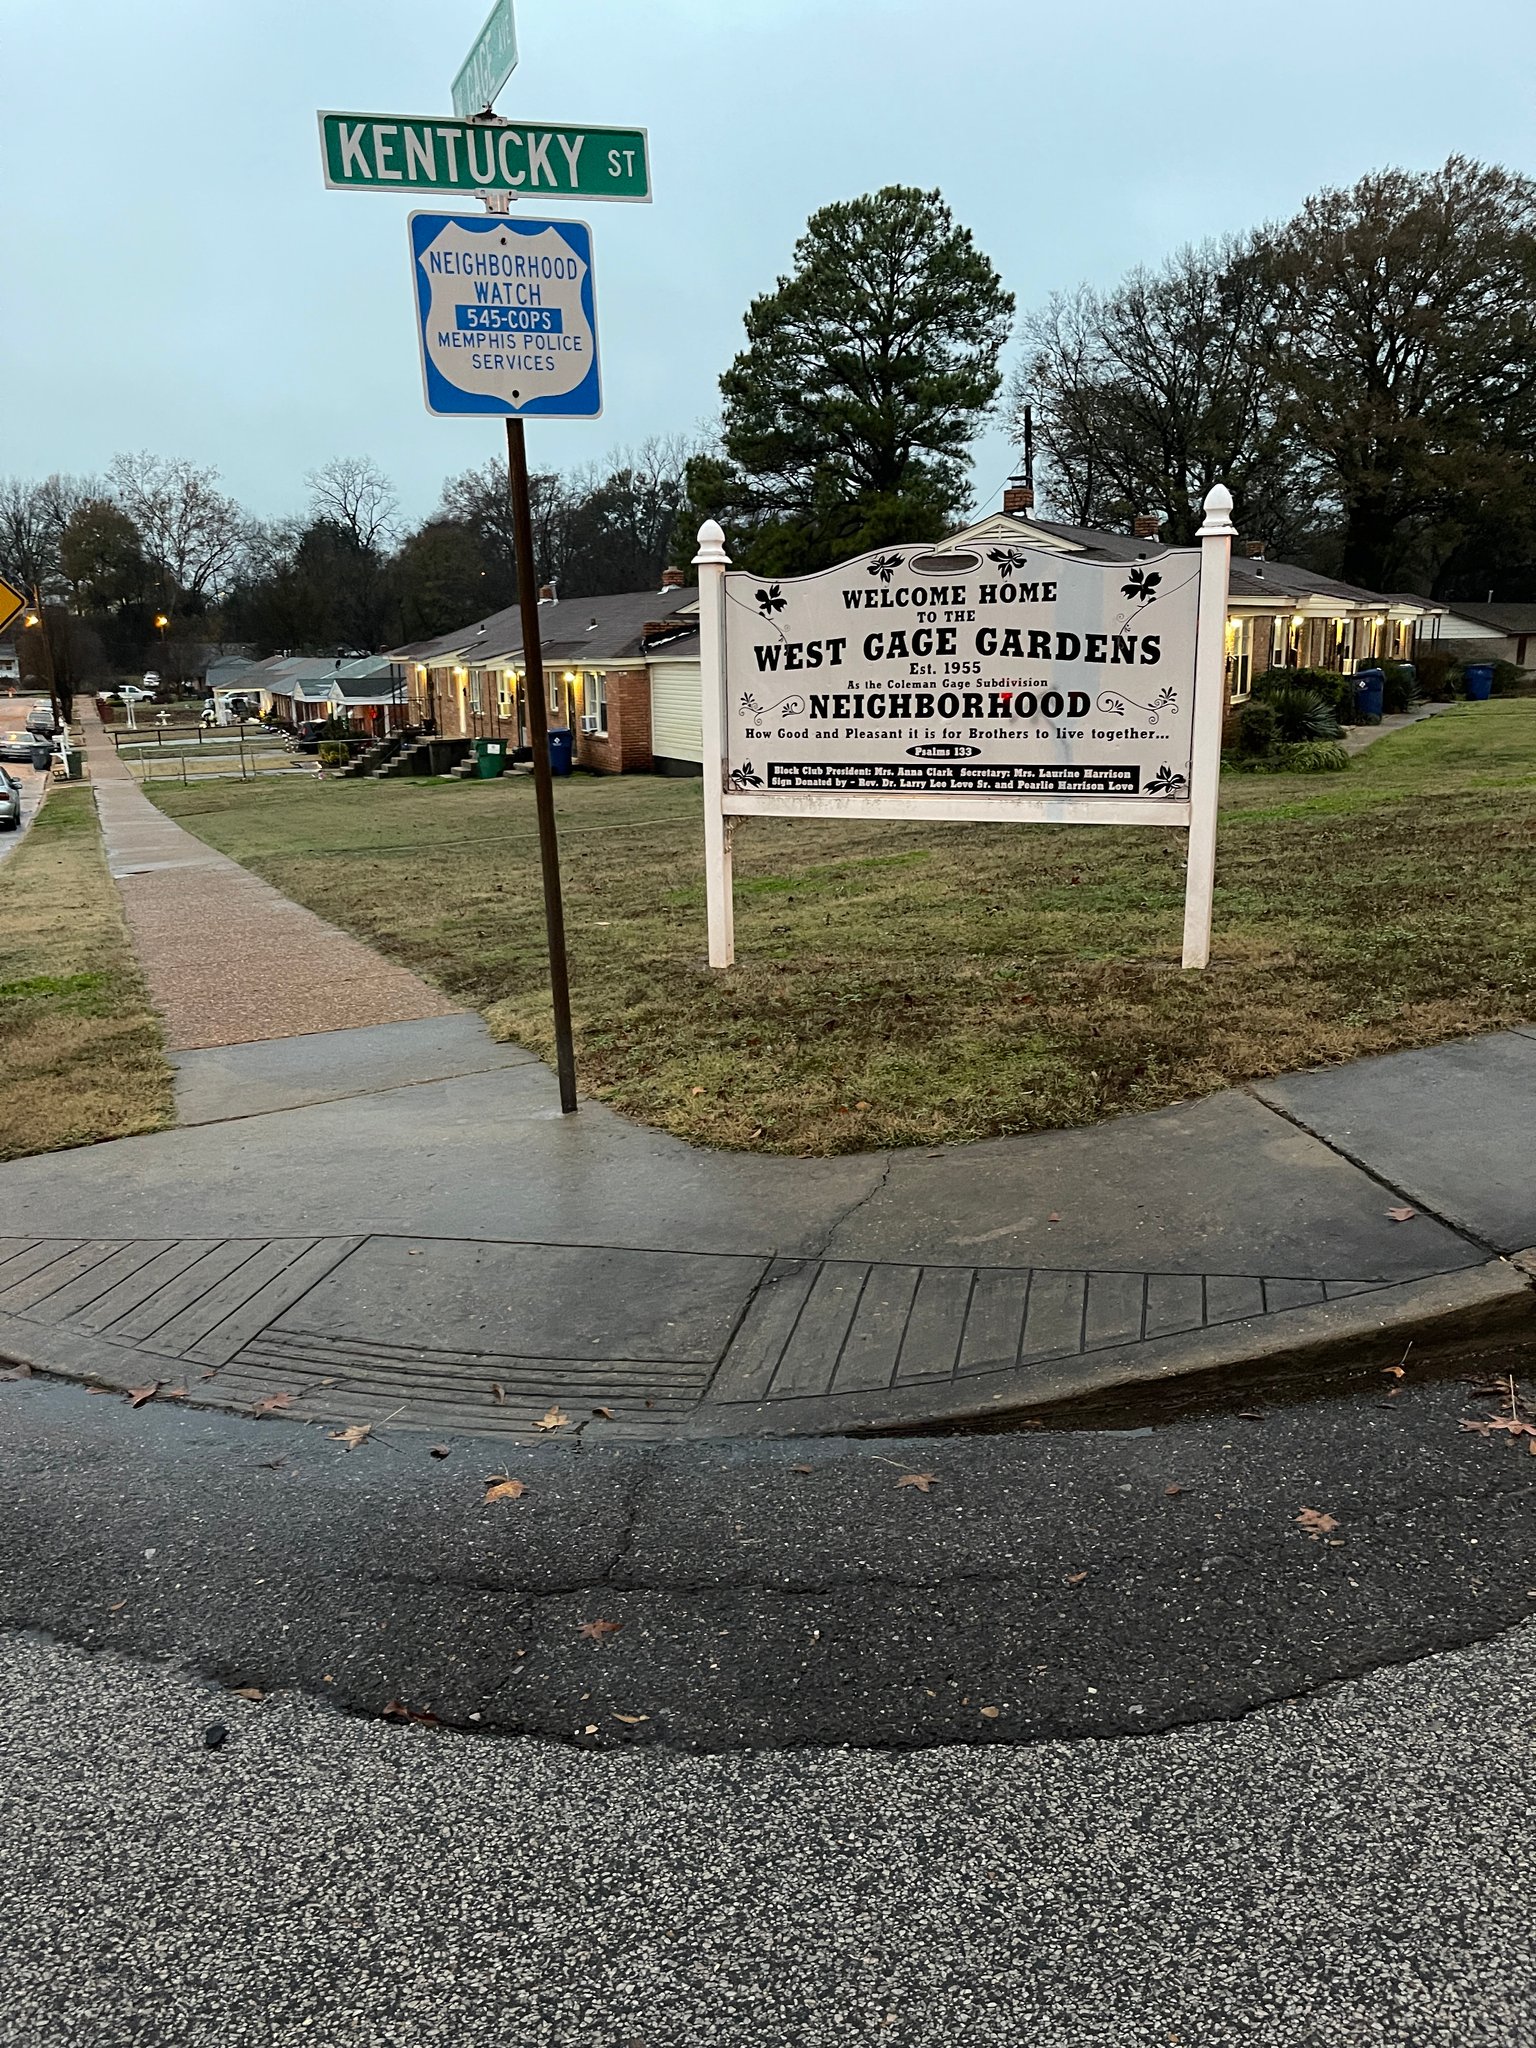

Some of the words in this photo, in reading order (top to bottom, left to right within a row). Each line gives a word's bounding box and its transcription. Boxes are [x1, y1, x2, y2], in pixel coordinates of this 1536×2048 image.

[338, 122, 585, 188] KENTUCKY
[607, 149, 635, 177] ST
[429, 251, 577, 280] NEIGHBORHOOD
[474, 281, 541, 306] WATCH
[467, 308, 552, 330] 545-COPS
[438, 331, 516, 349] MEMPHIS
[524, 334, 583, 351] POLICE
[472, 353, 555, 371] SERVICES
[842, 585, 966, 609] WELCOME
[978, 582, 1057, 604] HOME
[917, 611, 937, 623] TO
[944, 610, 976, 623] THE
[753, 637, 847, 672] WEST
[863, 627, 957, 661] GAGE
[975, 627, 1161, 665] GARDENS
[909, 662, 936, 675] Est.
[944, 661, 982, 674] 1955
[847, 680, 860, 690] As
[865, 679, 882, 690] the
[887, 679, 937, 689] Coleman
[942, 679, 971, 690] Gage
[976, 678, 1048, 688] Subdivision
[809, 691, 1091, 719] NEIGHBORHOOD
[745, 728, 772, 739] How
[777, 728, 809, 739] Good
[815, 728, 839, 739] and
[845, 728, 903, 739] Pleasant
[908, 727, 918, 739] it
[924, 728, 936, 739] is
[942, 727, 962, 739] for
[968, 728, 1029, 739] Brothers
[1036, 728, 1049, 739] to
[1056, 728, 1084, 739] live
[1091, 728, 1170, 742] together...
[914, 747, 951, 757] Psalms
[953, 747, 973, 757] 133
[774, 766, 799, 775] Block
[801, 766, 823, 775] Club
[825, 766, 872, 776] President:
[874, 767, 895, 776] Mrs.
[897, 767, 923, 776] Anna
[926, 767, 953, 777] Clark
[960, 768, 1011, 778] Secretary:
[1013, 768, 1036, 778] Mrs.
[1038, 768, 1080, 778] Laurine
[1083, 769, 1131, 779] Harrison
[772, 777, 792, 787] Sign
[795, 777, 832, 786] Donated
[835, 777, 847, 788] by
[858, 778, 879, 787] Rev.
[881, 778, 897, 787] Dr.
[899, 778, 927, 789] Larry
[929, 779, 947, 788] Lee
[950, 779, 974, 789] Love
[976, 779, 991, 789] Sr.
[994, 780, 1014, 789] and
[1017, 780, 1054, 790] Pearlie
[1057, 781, 1105, 790] Harrison
[1108, 781, 1134, 791] Love
